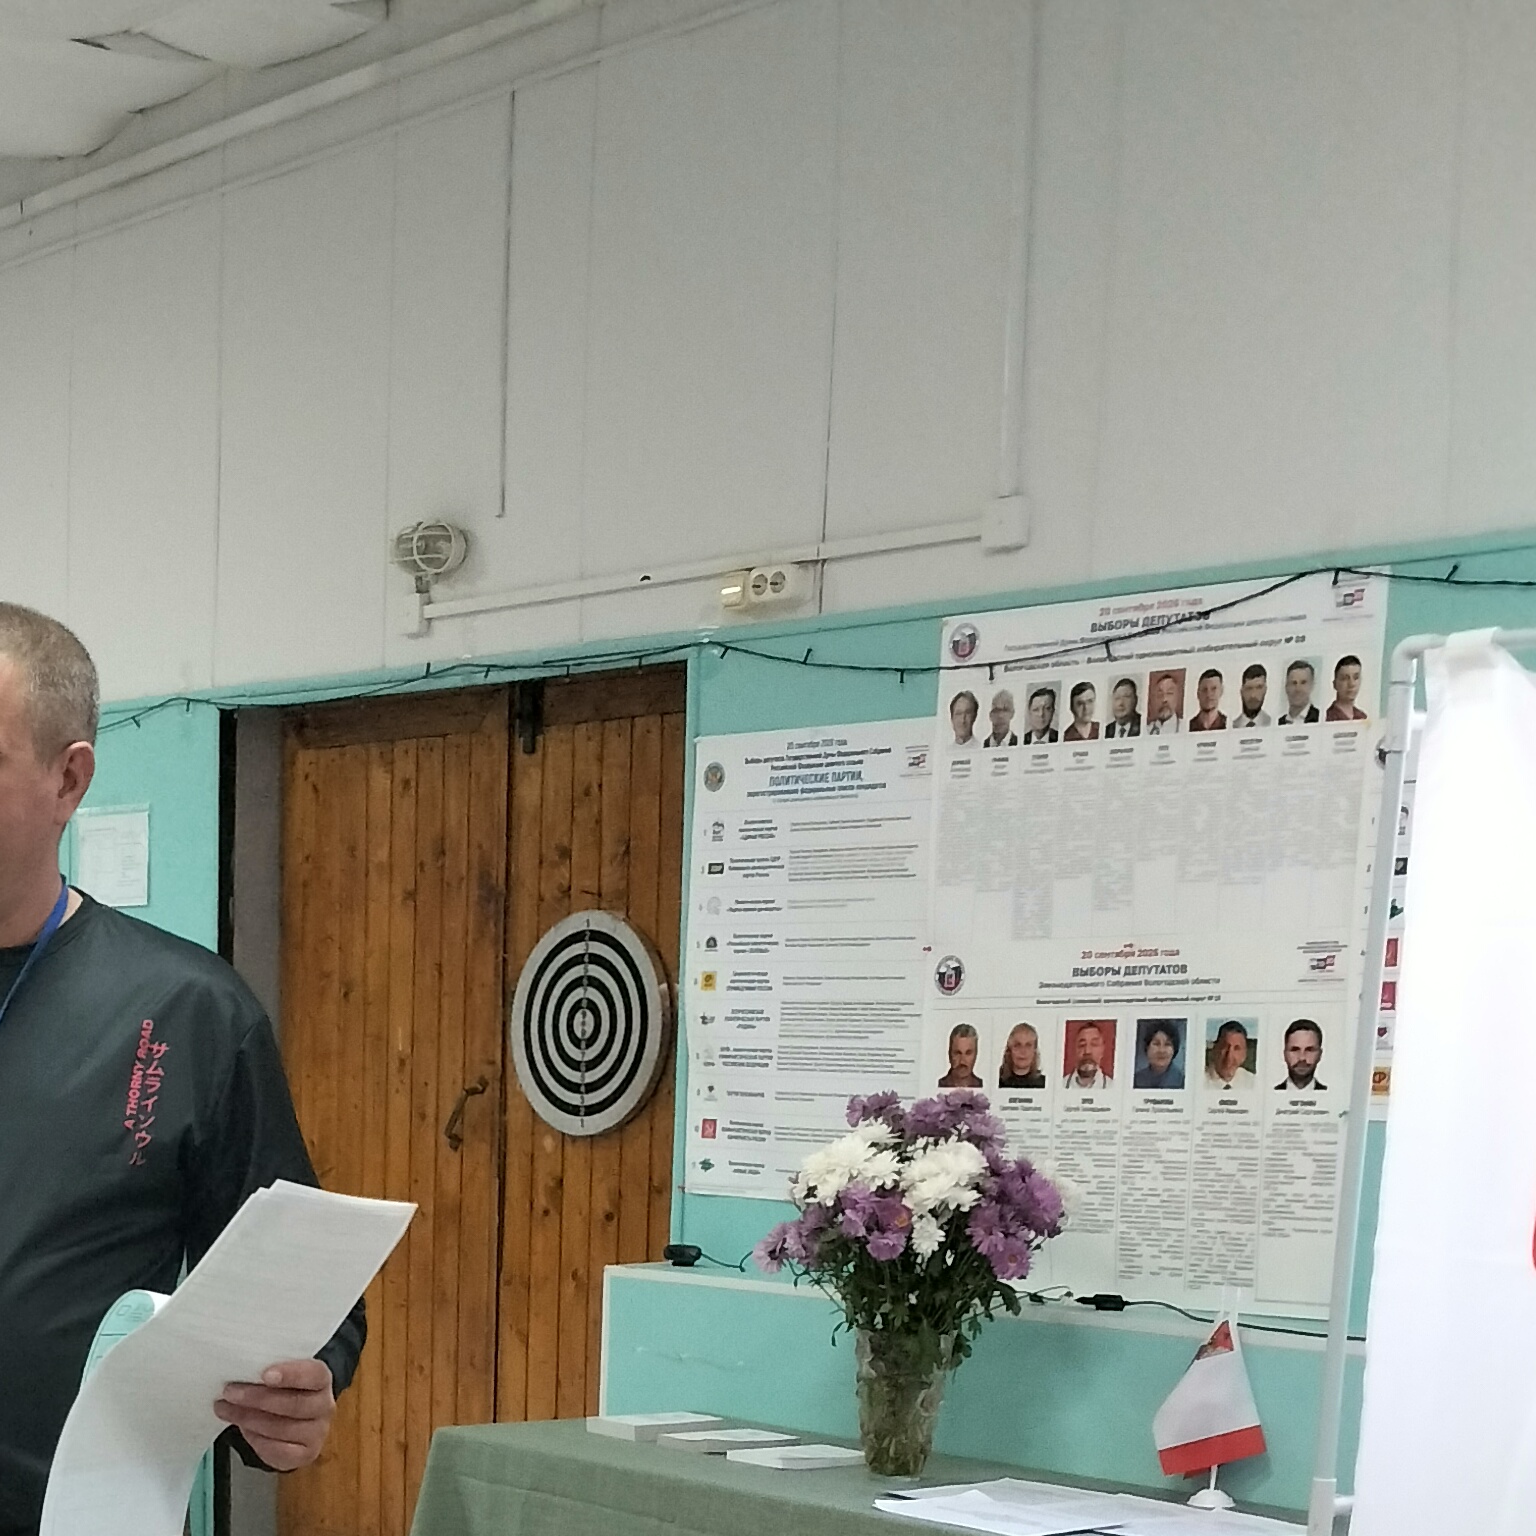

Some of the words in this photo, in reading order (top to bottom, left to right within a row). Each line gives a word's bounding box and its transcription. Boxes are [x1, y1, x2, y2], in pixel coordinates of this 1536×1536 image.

[1090, 617, 1139, 633] ВЫБОРЫ
[1072, 965, 1121, 978] ВЫБОРЫ
[1123, 963, 1188, 978] ДЕПУТАТОВ
[136, 1019, 154, 1059] ROAD
[125, 1060, 145, 1117] THORNY
[123, 1118, 135, 1131] A
